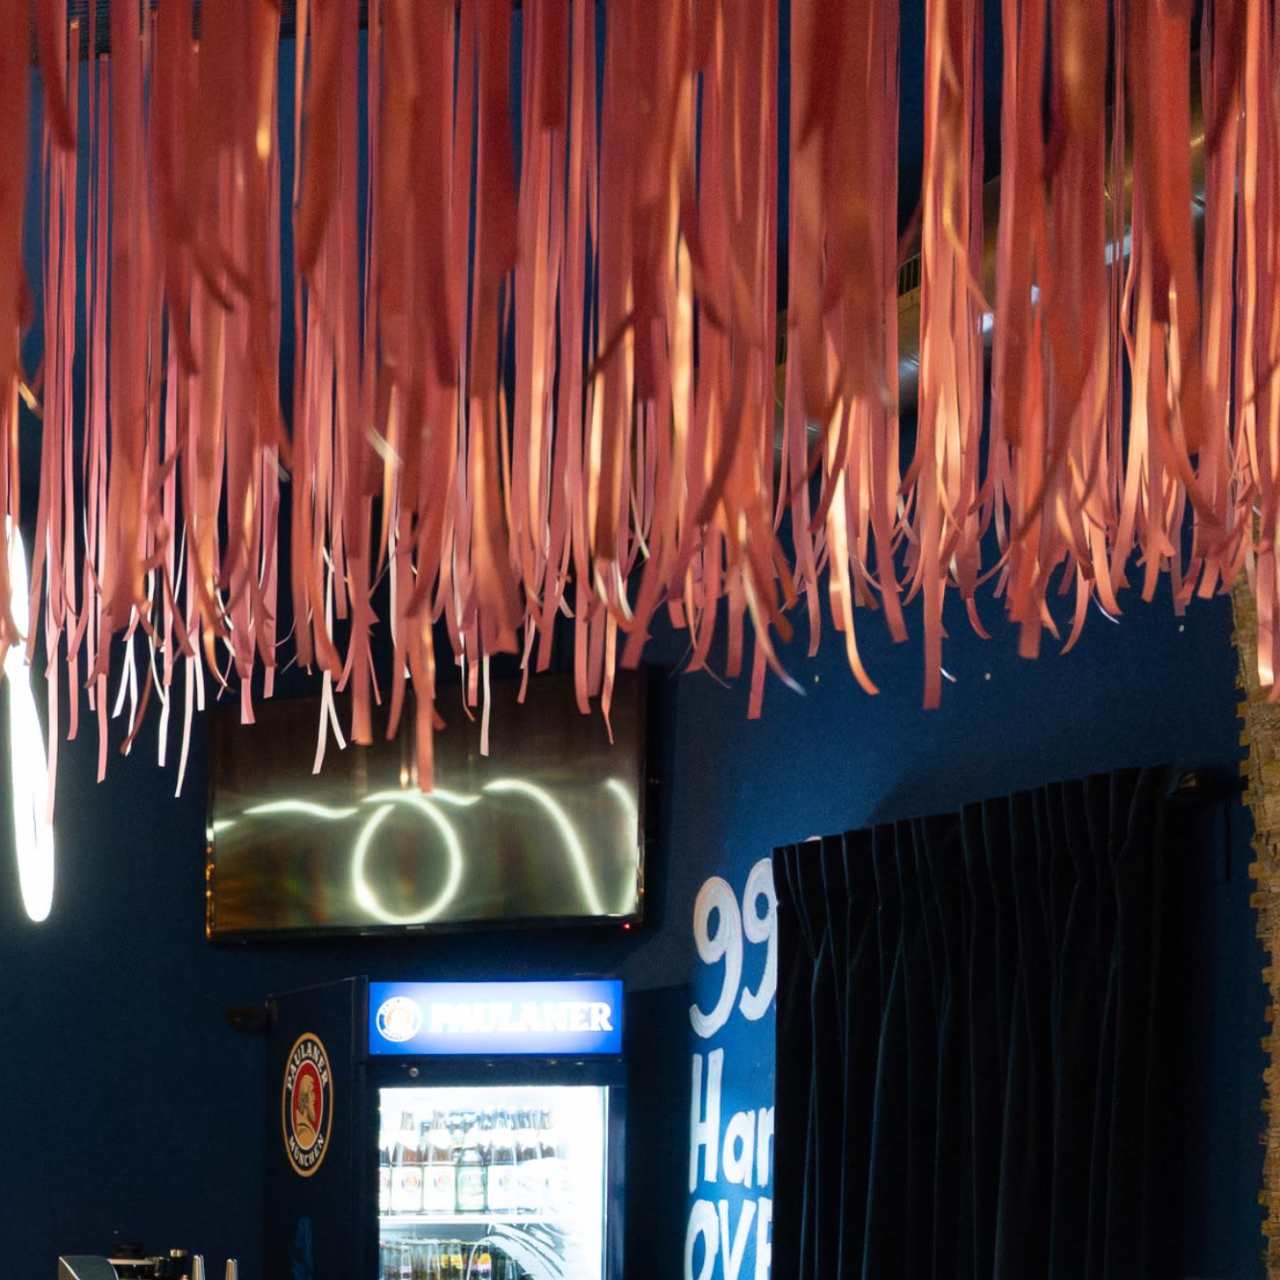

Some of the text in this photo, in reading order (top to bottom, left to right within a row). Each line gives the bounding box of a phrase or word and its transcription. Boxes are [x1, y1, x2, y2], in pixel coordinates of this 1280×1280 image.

[689, 859, 778, 1040] 99
[429, 1001, 614, 1032] PAULANER
[287, 1041, 329, 1090] PAULANER
